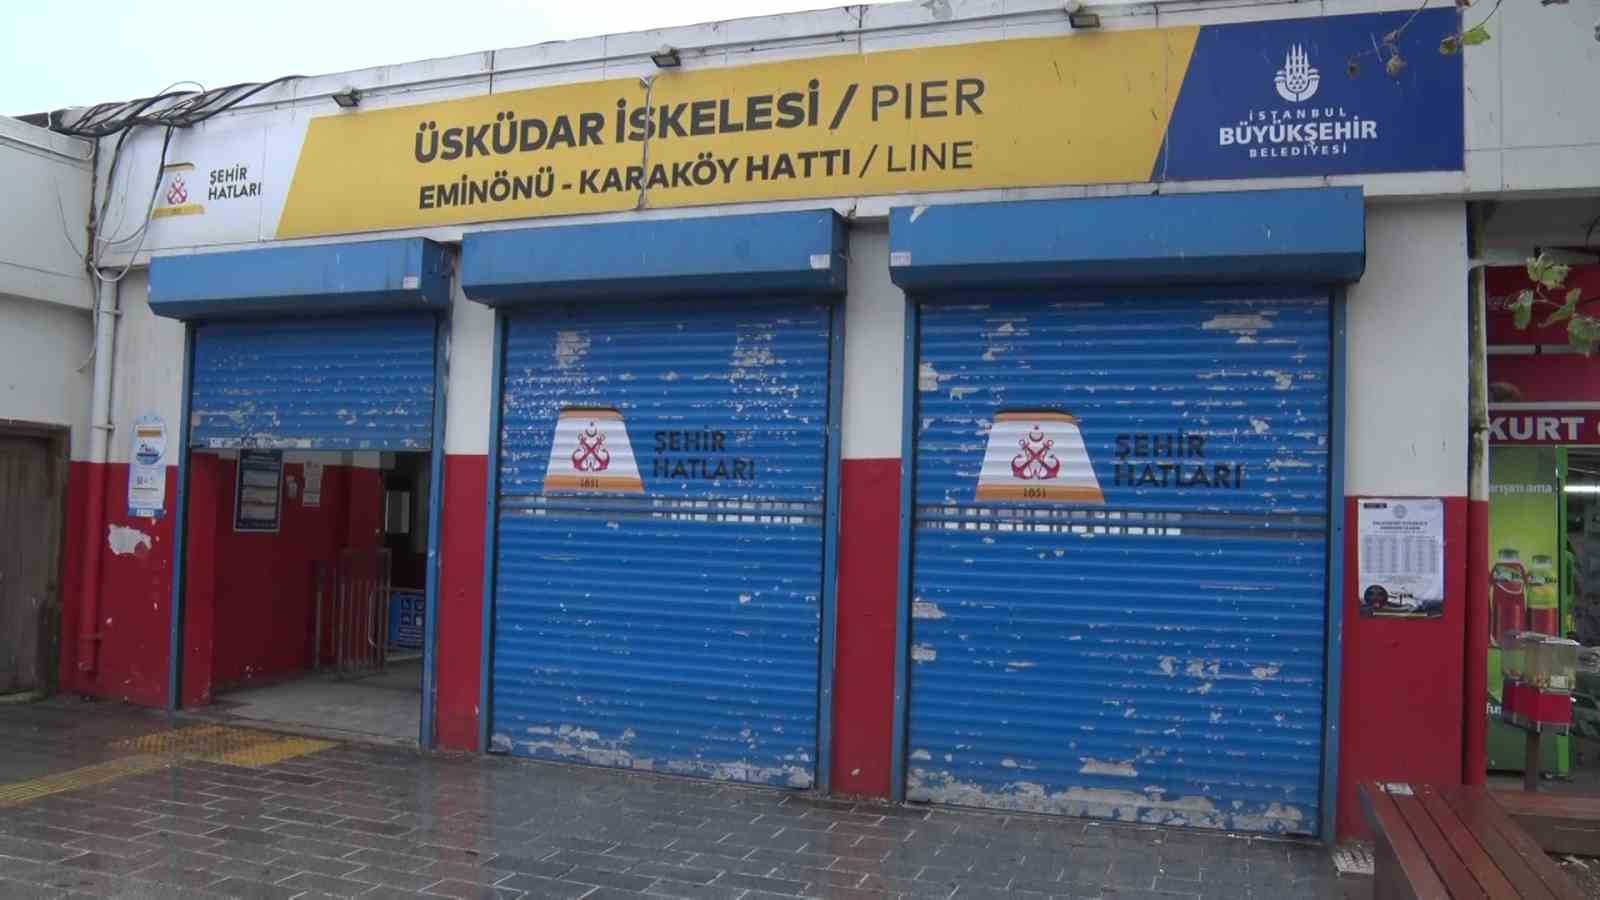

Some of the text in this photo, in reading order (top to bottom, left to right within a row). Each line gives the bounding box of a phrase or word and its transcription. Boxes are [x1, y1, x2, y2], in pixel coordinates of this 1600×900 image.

[415, 77, 986, 164] ÜSKÜDAR İSKELESİ / PIER
[1249, 107, 1346, 121] İSTANBUL
[1219, 115, 1377, 146] BÜYÜKŞEHİR
[1249, 142, 1347, 158] BELEDİYESİ
[209, 163, 248, 185] ŞEHİR
[418, 141, 974, 210] EMİNÖNÜ - KARAKÖY HATTI / LINE
[208, 182, 262, 200] HATLARI
[655, 425, 727, 454] ŞEHİR
[1488, 416, 1585, 440] KURT
[1114, 428, 1207, 460] ŞEHİR
[653, 459, 755, 480] HATLARI
[1114, 463, 1245, 489] HATLARI
